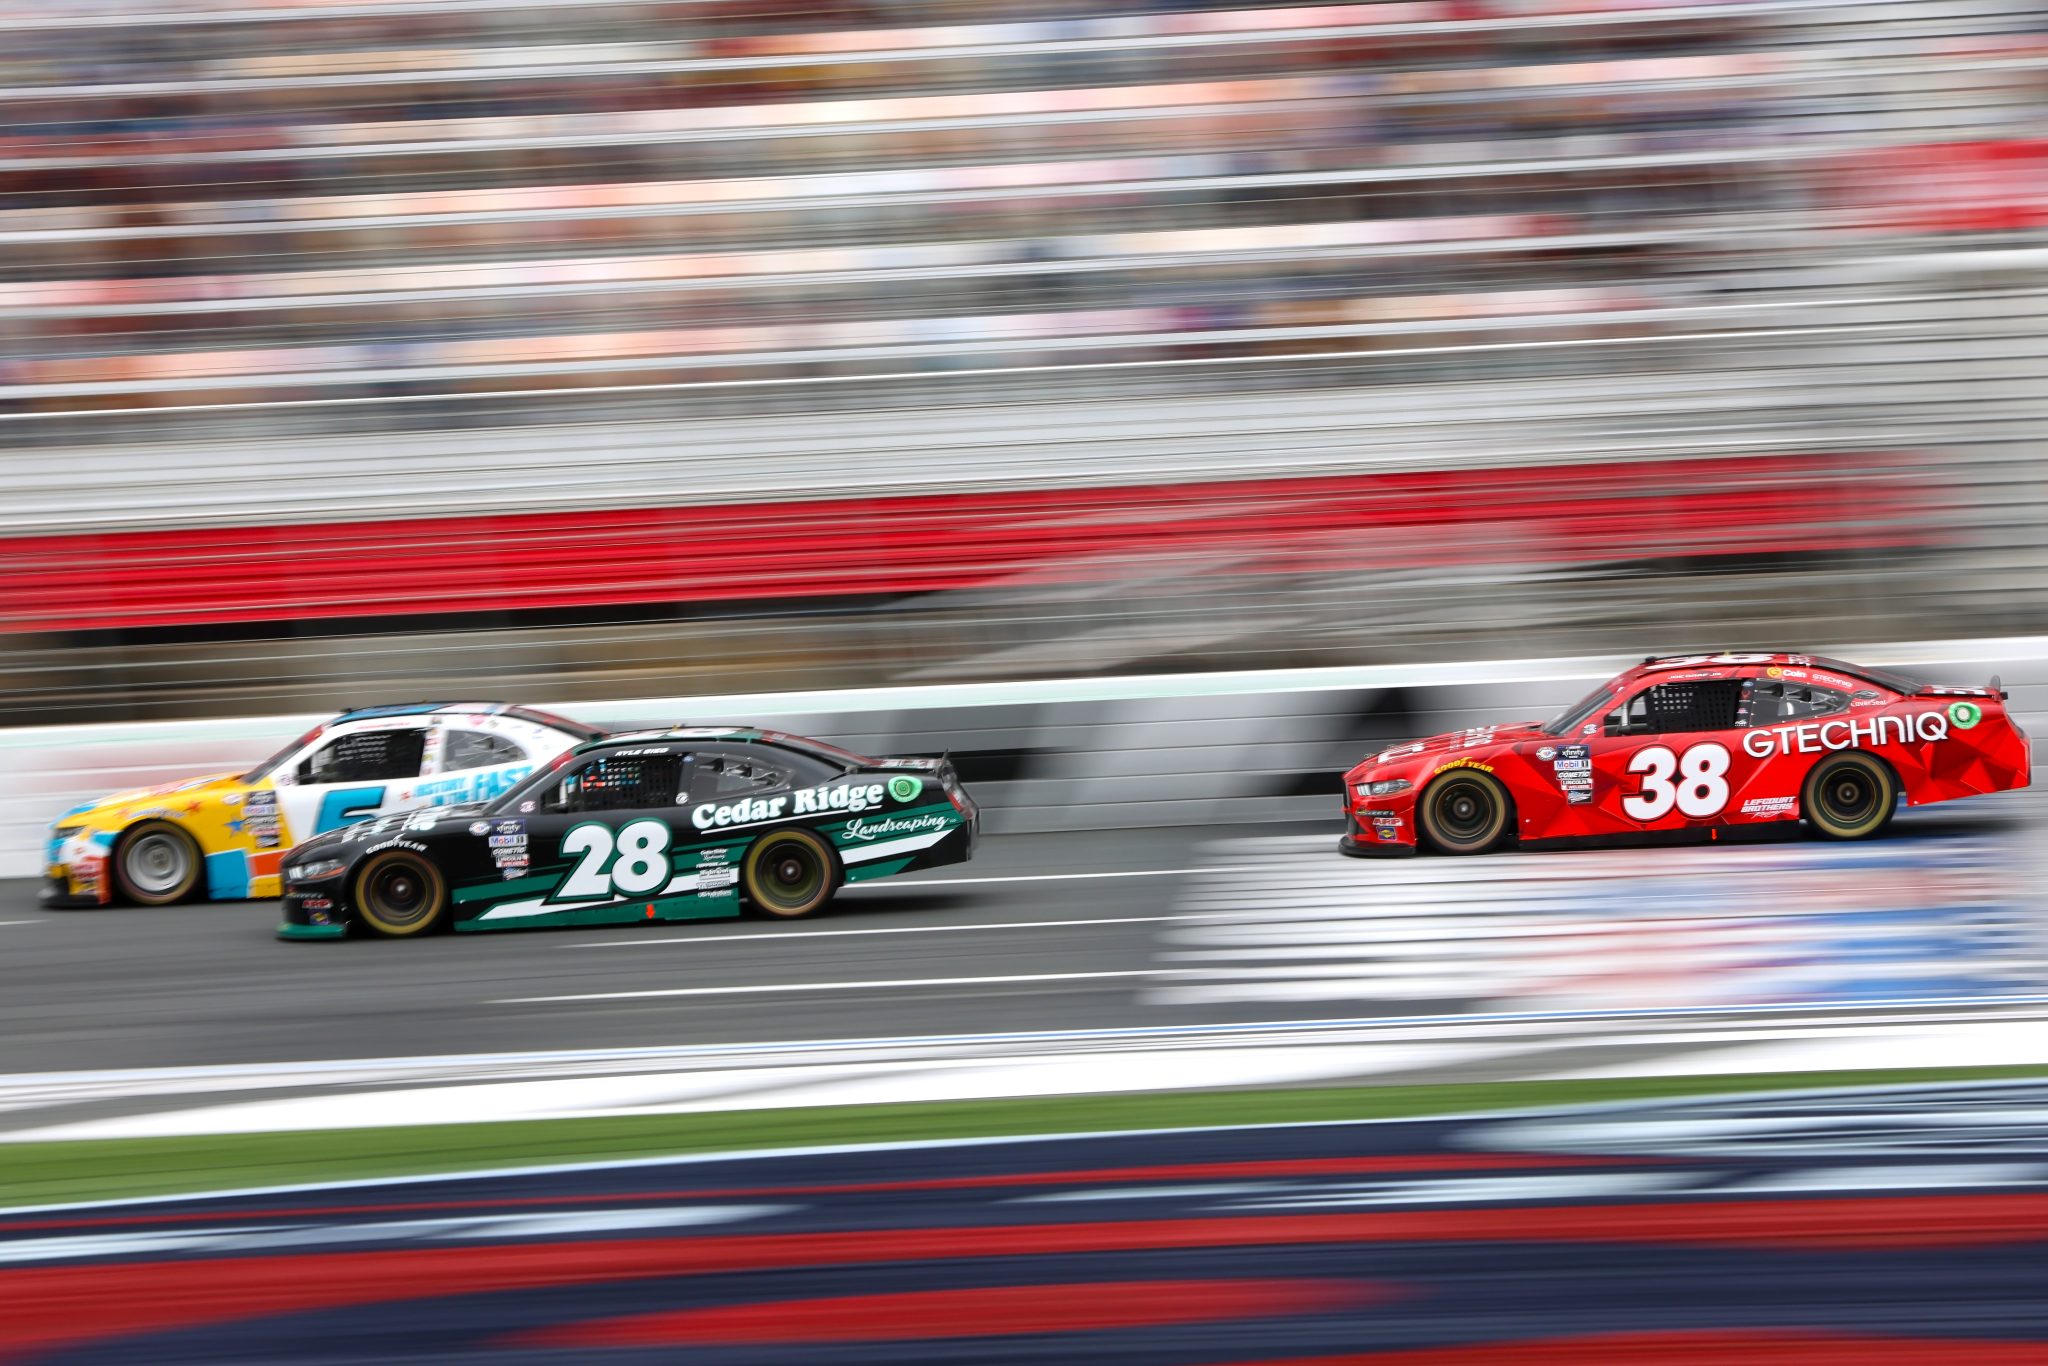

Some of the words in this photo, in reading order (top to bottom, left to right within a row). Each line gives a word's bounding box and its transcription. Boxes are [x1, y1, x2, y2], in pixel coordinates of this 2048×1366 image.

[1783, 669, 1807, 678] Coin
[1743, 711, 1949, 758] GTECHNIQ
[1562, 749, 1585, 758] xfinity
[1556, 761, 1579, 769] Mobil
[1622, 742, 1732, 821] 38
[692, 797, 787, 830] Cedar
[793, 784, 885, 813] Ridge
[496, 824, 520, 834] xfinity
[841, 814, 949, 841] Landscaping
[491, 835, 514, 845] Mobil
[554, 820, 671, 899] 28
